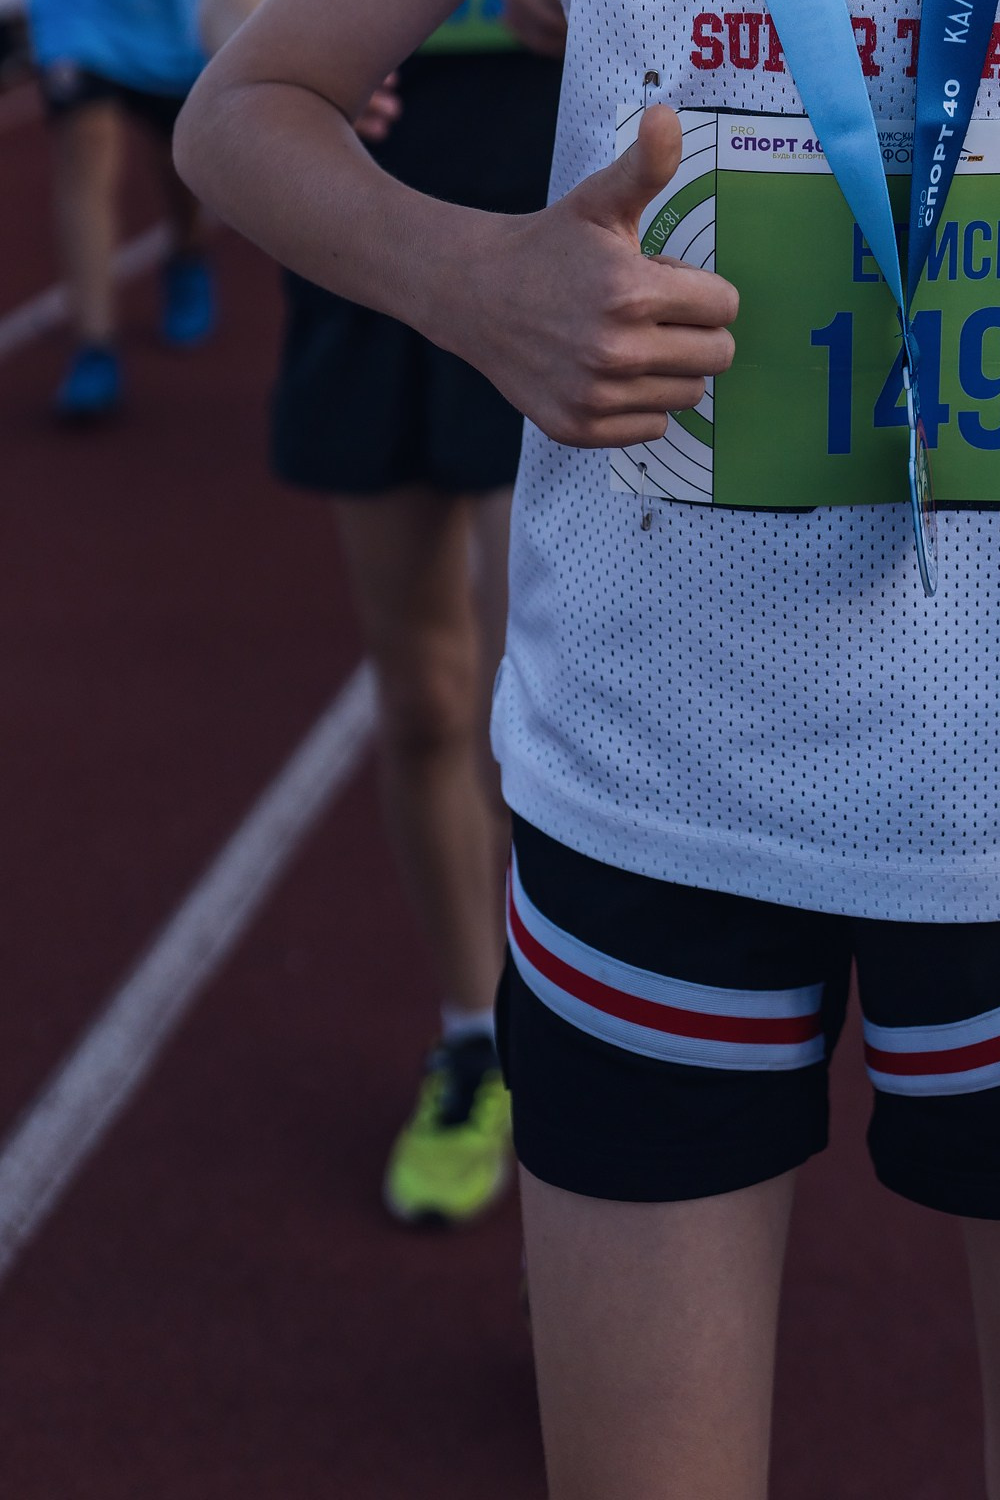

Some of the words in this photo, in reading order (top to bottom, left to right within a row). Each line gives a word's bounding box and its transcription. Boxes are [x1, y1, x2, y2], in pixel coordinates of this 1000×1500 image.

[690, 12, 880, 77] SUR
[730, 125, 755, 135] PRO
[731, 136, 798, 153] СПОРТ
[925, 124, 954, 227] СПОРТ
[943, 79, 960, 117] 40
[652, 207, 680, 241] 18:20
[918, 189, 927, 228] PRO
